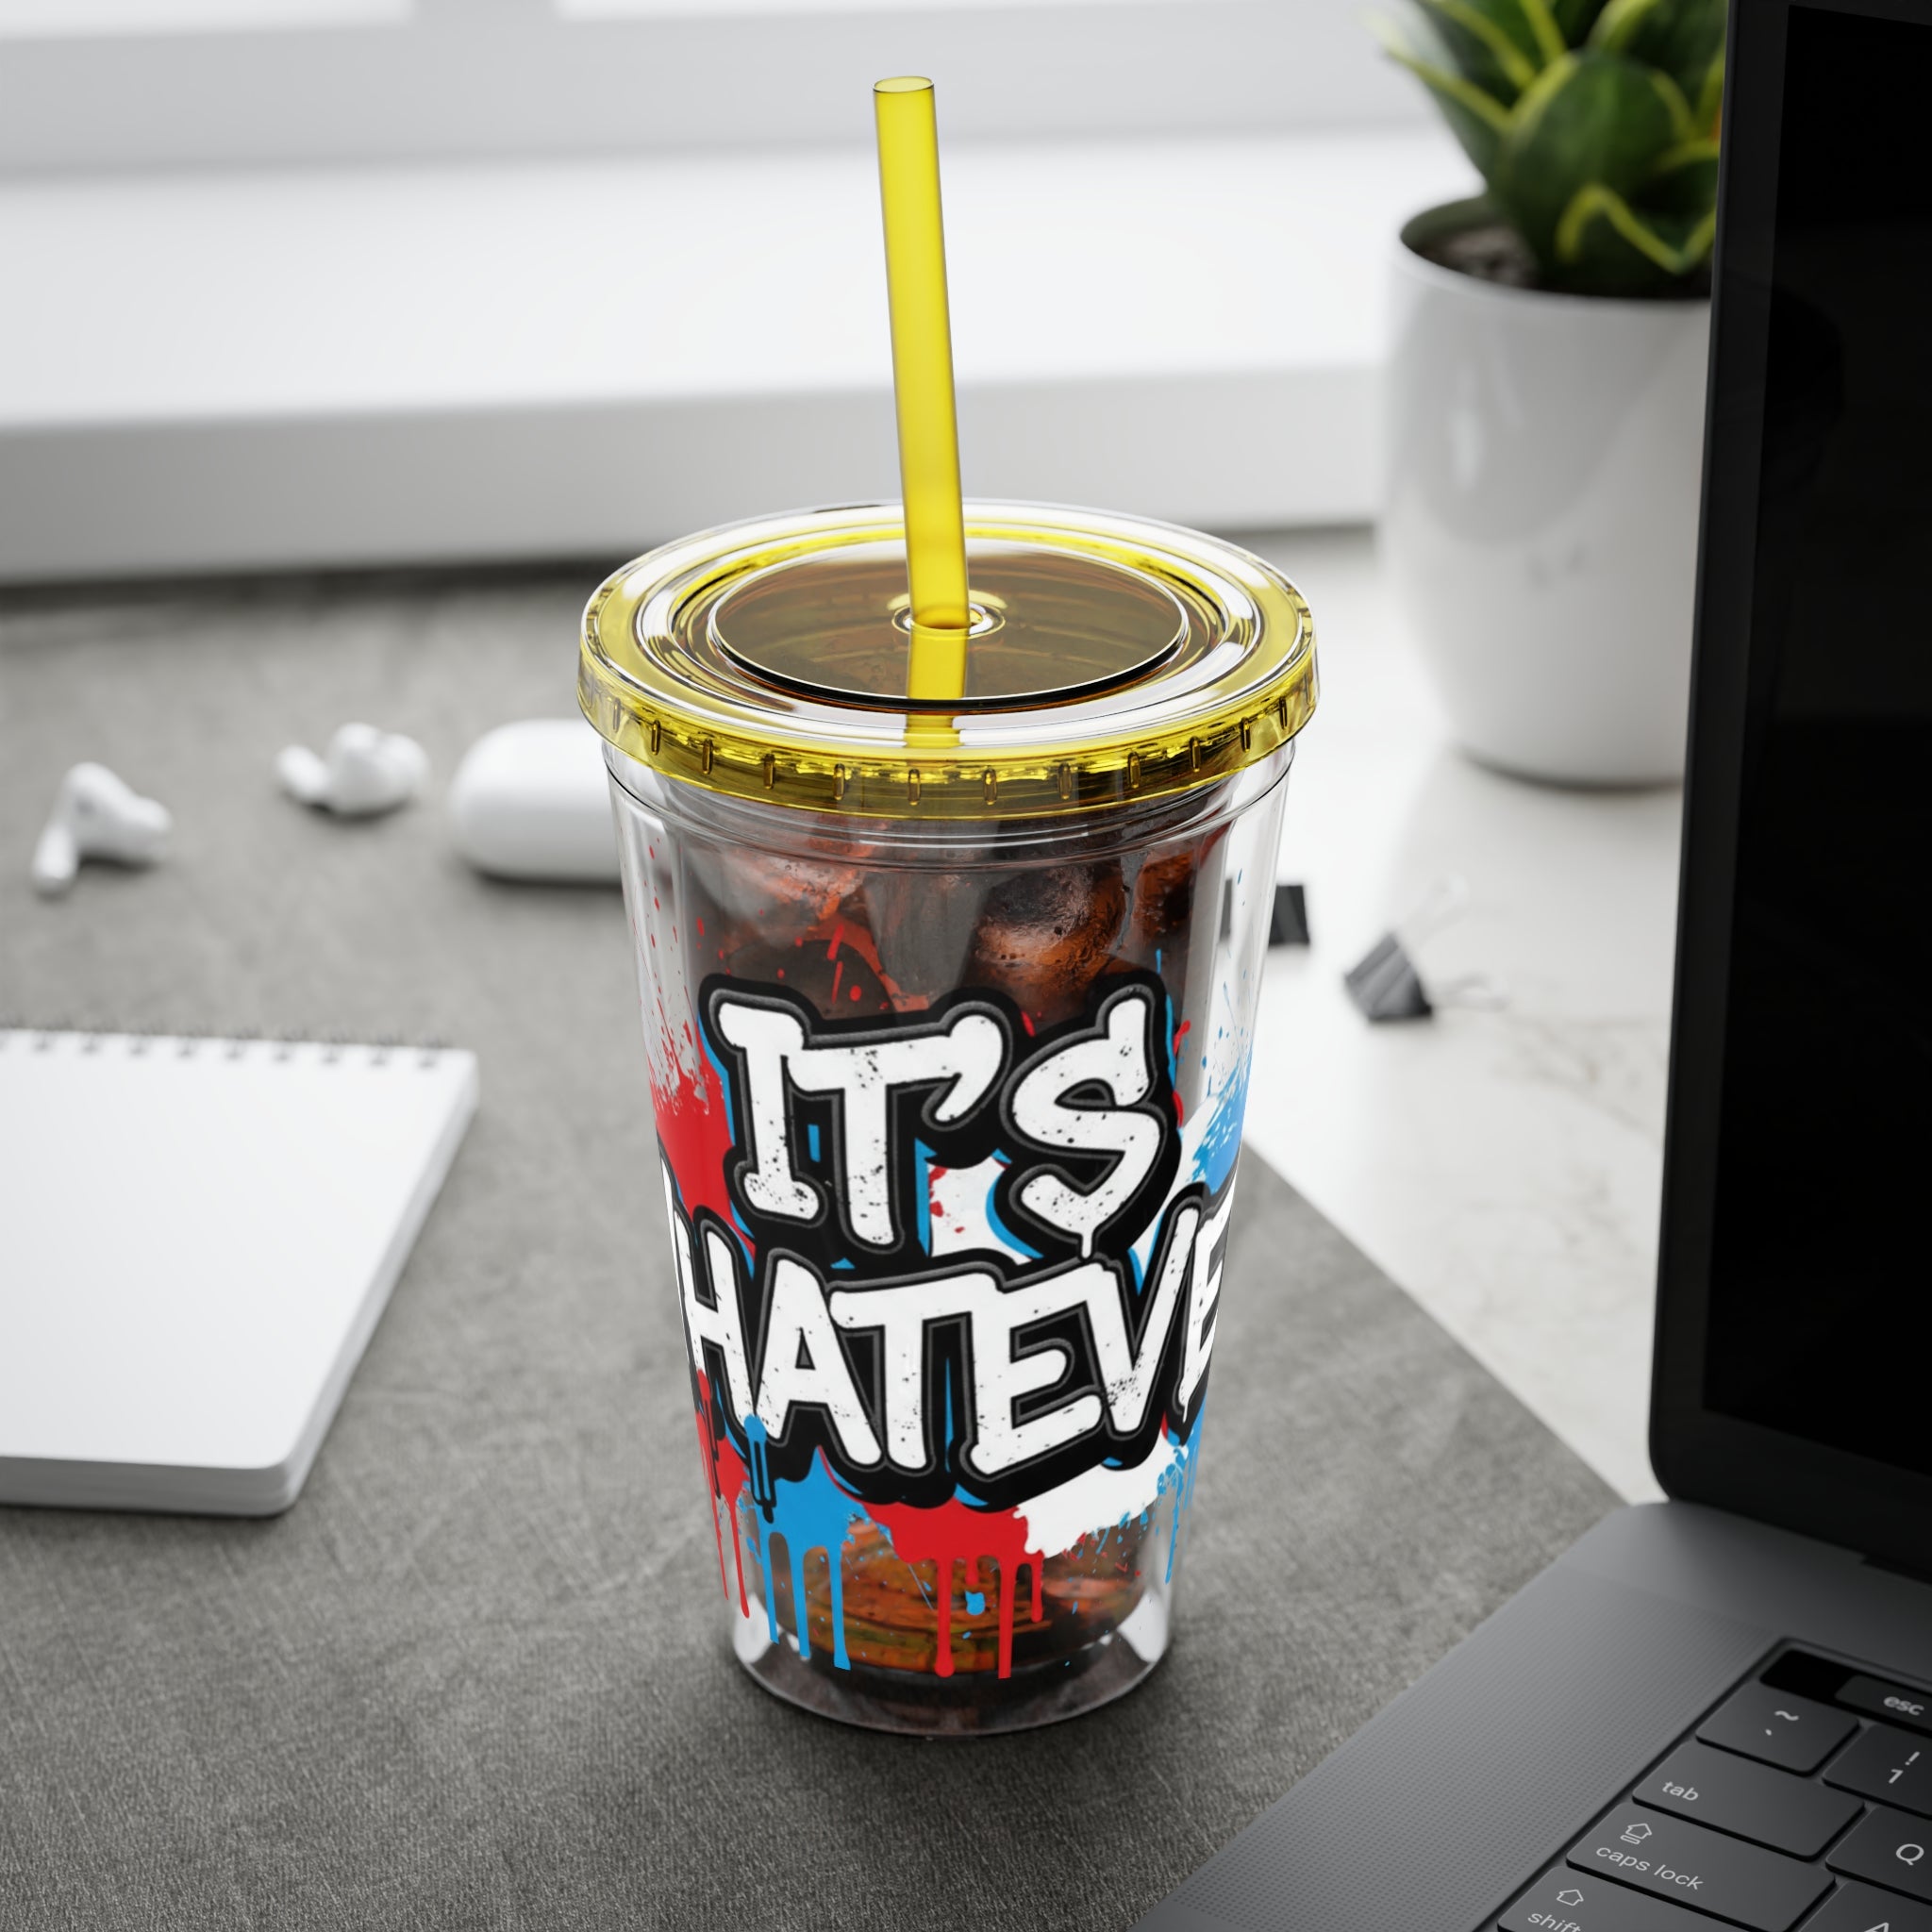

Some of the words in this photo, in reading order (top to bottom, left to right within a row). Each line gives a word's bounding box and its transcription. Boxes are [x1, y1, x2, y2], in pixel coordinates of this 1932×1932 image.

[717, 995, 1161, 1257] IT'S
[660, 1158, 1237, 1474] HATEVE
[1883, 1696, 1924, 1716] esc
[1661, 1781, 1699, 1801] tab
[1895, 1843, 1924, 1866] Q
[1595, 1847, 1651, 1872] caps
[1653, 1864, 1704, 1890] lock
[1527, 1913, 1582, 1932] shift
